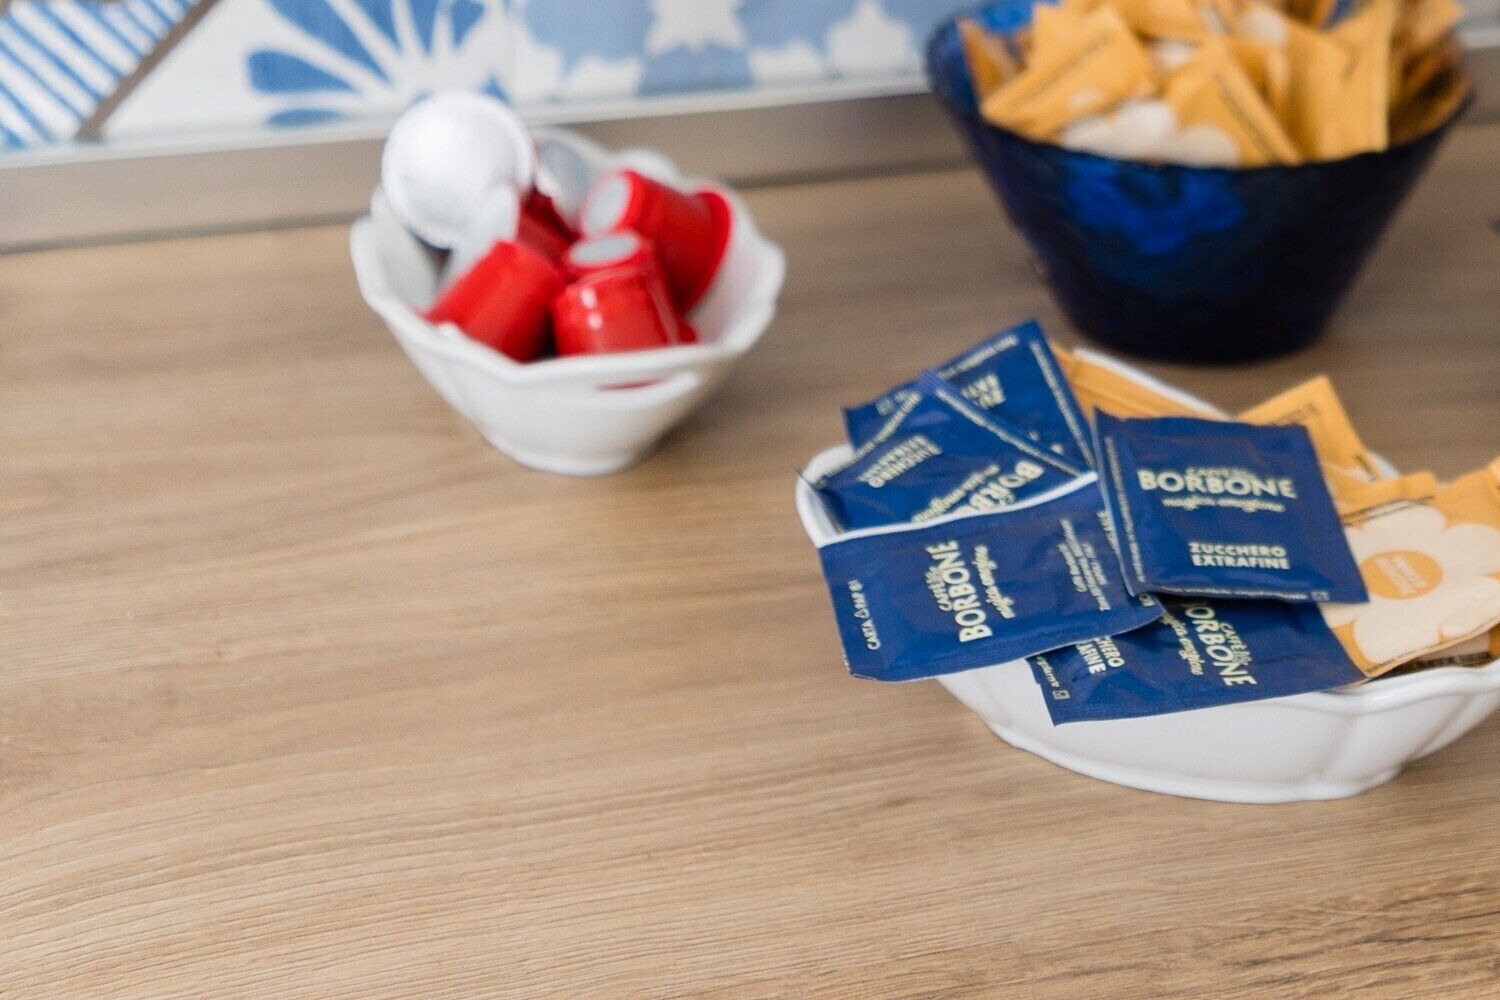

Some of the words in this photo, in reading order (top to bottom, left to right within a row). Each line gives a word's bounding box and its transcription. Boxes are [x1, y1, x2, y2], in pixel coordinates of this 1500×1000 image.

[1137, 469, 1297, 498] BORBONE
[1188, 541, 1287, 567] ZUCCHERO
[1191, 554, 1291, 569] EXTRAFINE
[925, 541, 993, 643] BORBONE
[1185, 605, 1258, 687] ORBONE
